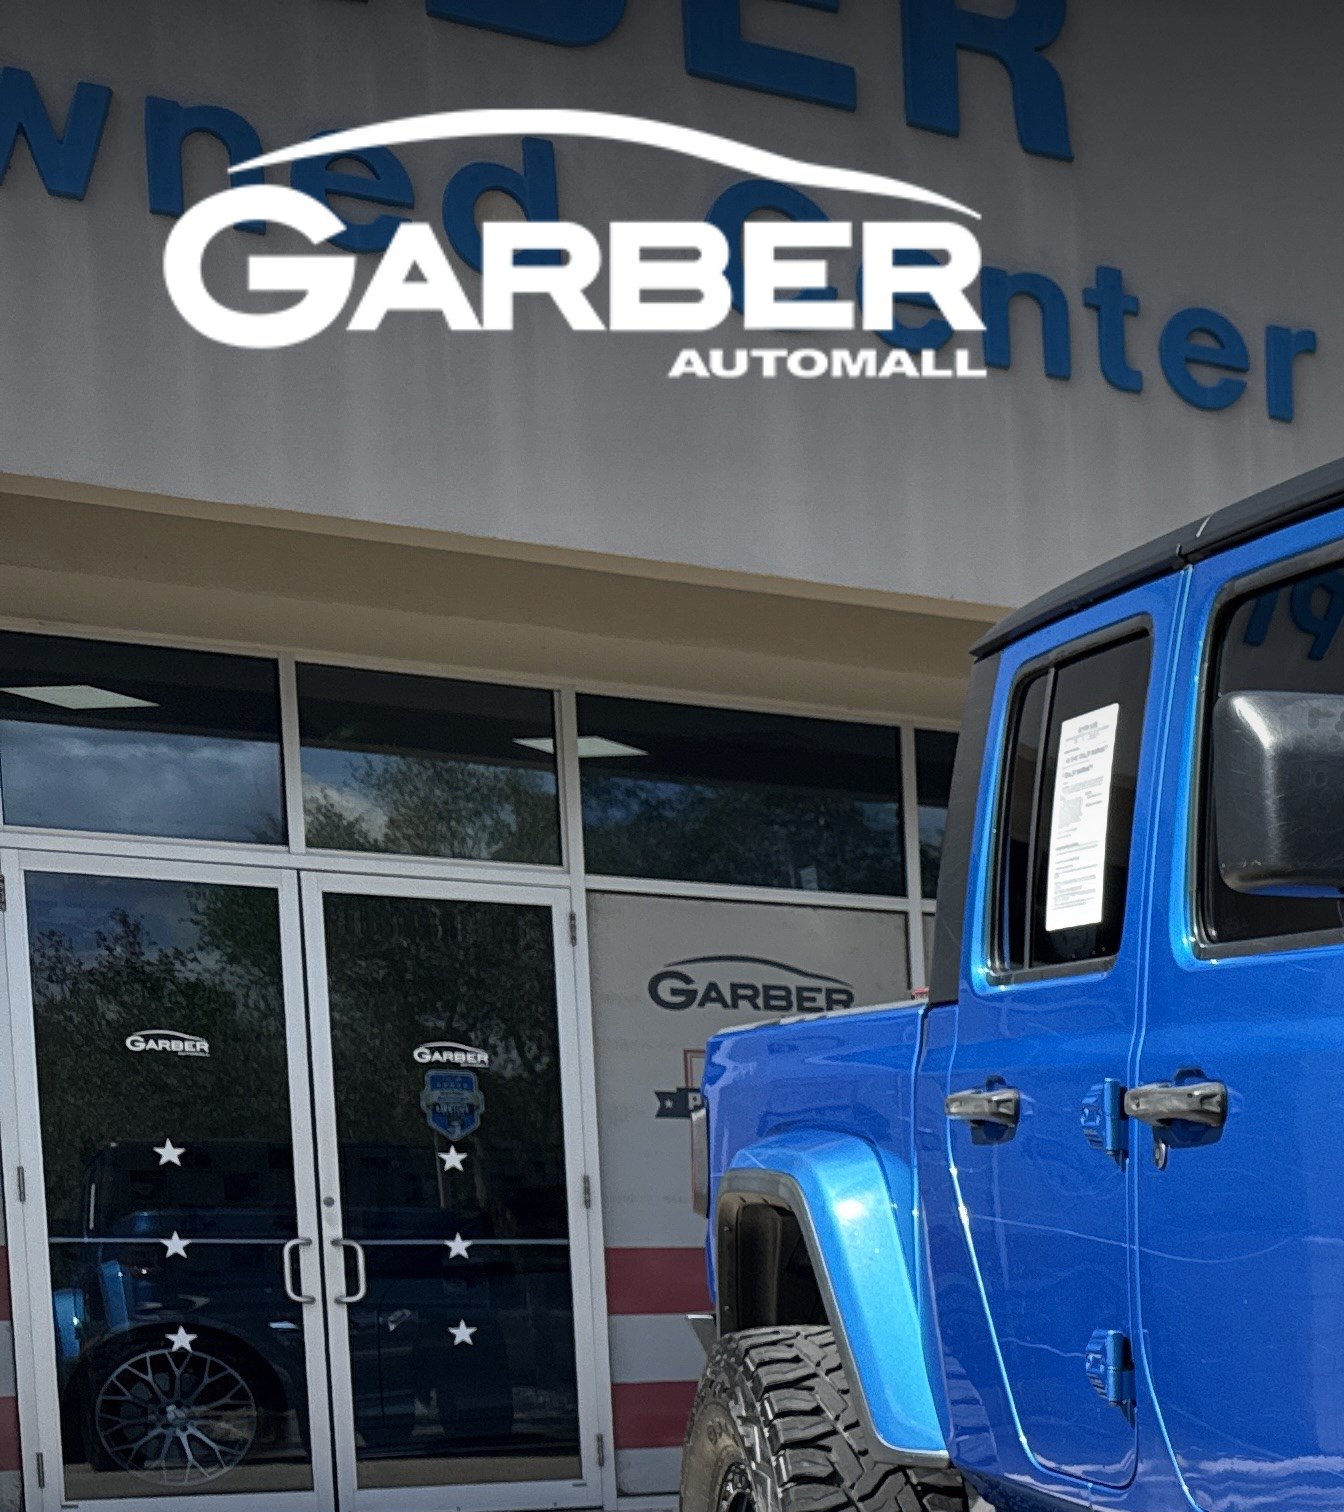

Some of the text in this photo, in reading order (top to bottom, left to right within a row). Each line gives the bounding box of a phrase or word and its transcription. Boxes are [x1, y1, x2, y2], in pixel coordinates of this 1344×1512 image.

[648, 970, 855, 1013] GARBER
[125, 1035, 210, 1055] GARBER
[413, 1046, 489, 1065] GARBER
